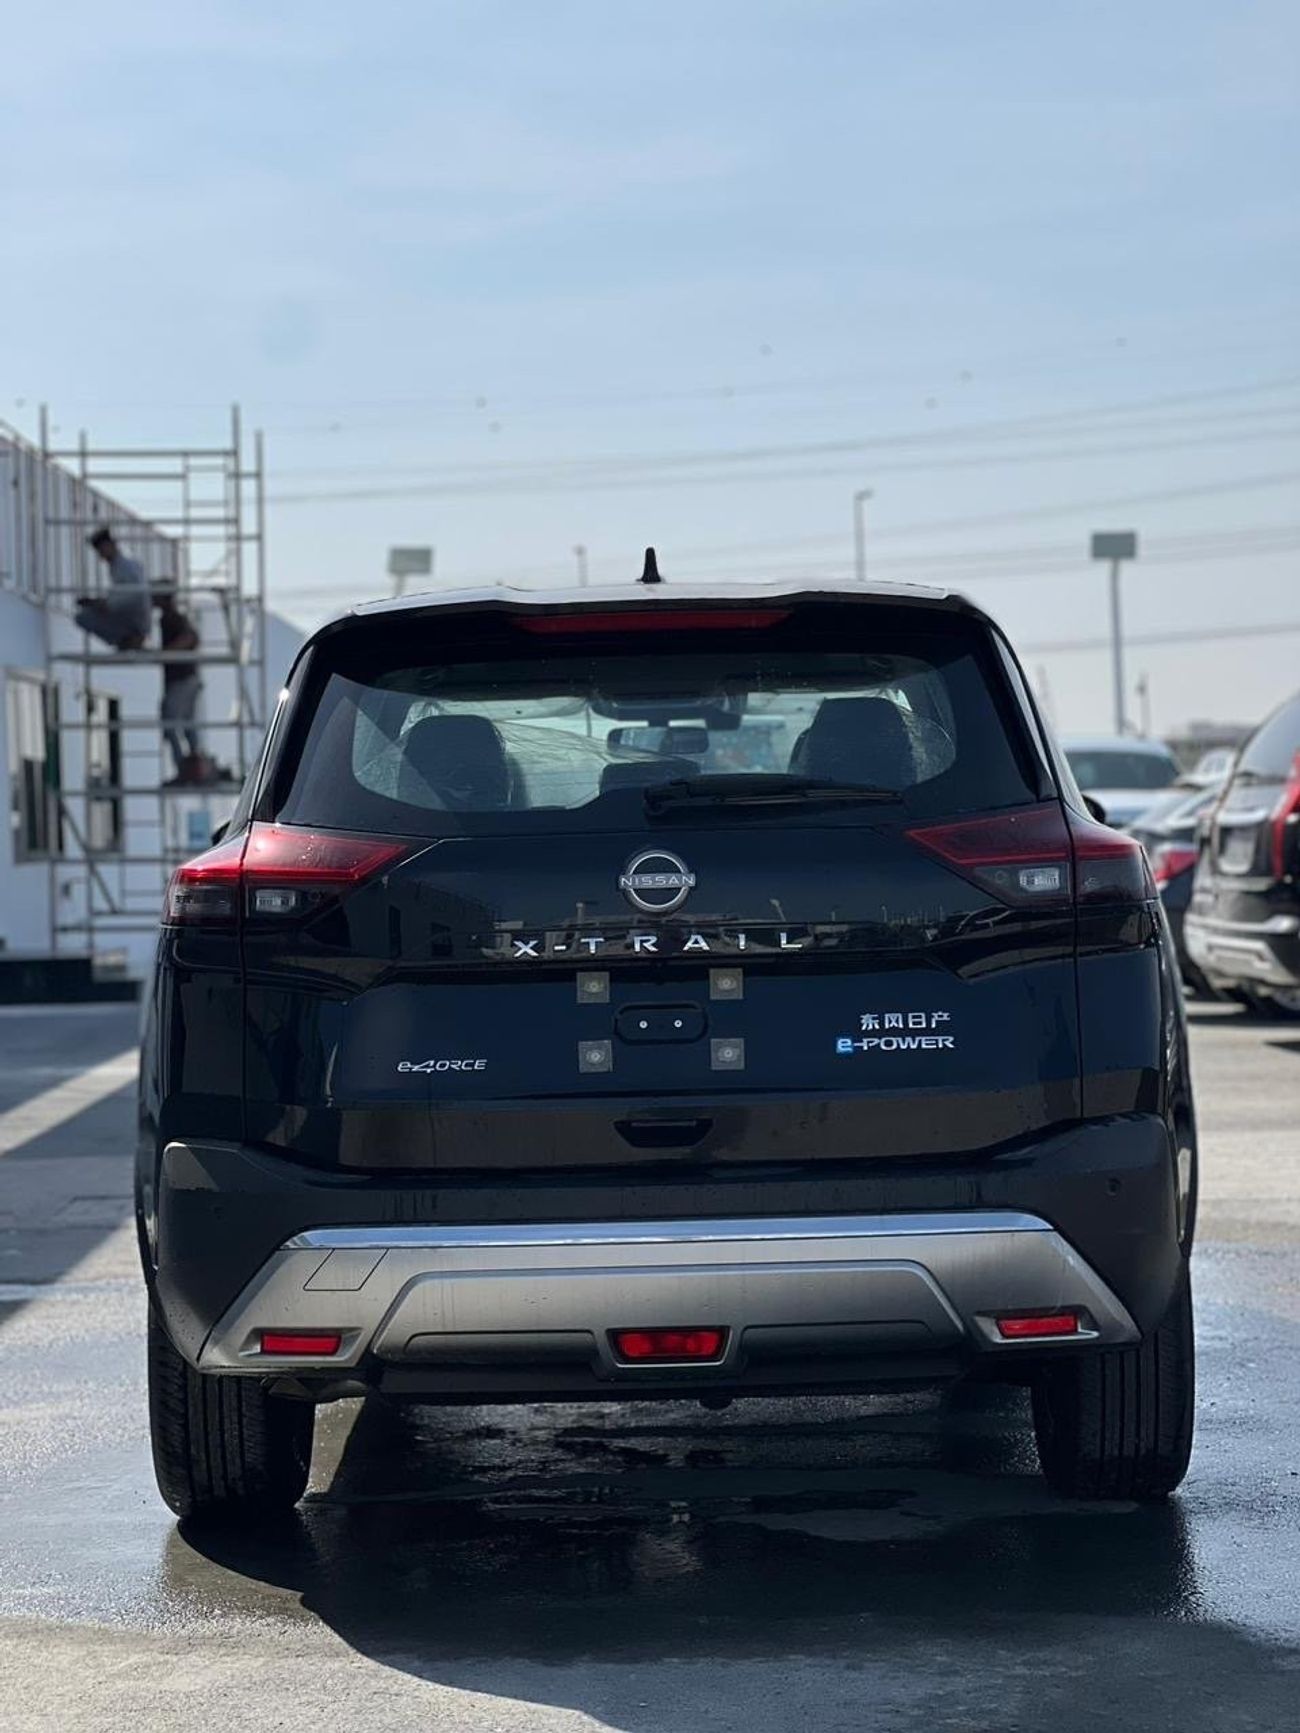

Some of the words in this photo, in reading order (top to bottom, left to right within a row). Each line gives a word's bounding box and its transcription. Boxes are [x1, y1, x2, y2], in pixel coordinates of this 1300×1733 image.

[621, 875, 694, 887] NISSAN
[513, 932, 803, 957] X-TRAIL
[860, 1011, 951, 1030] 东风日产
[835, 1036, 955, 1053] e-POWER
